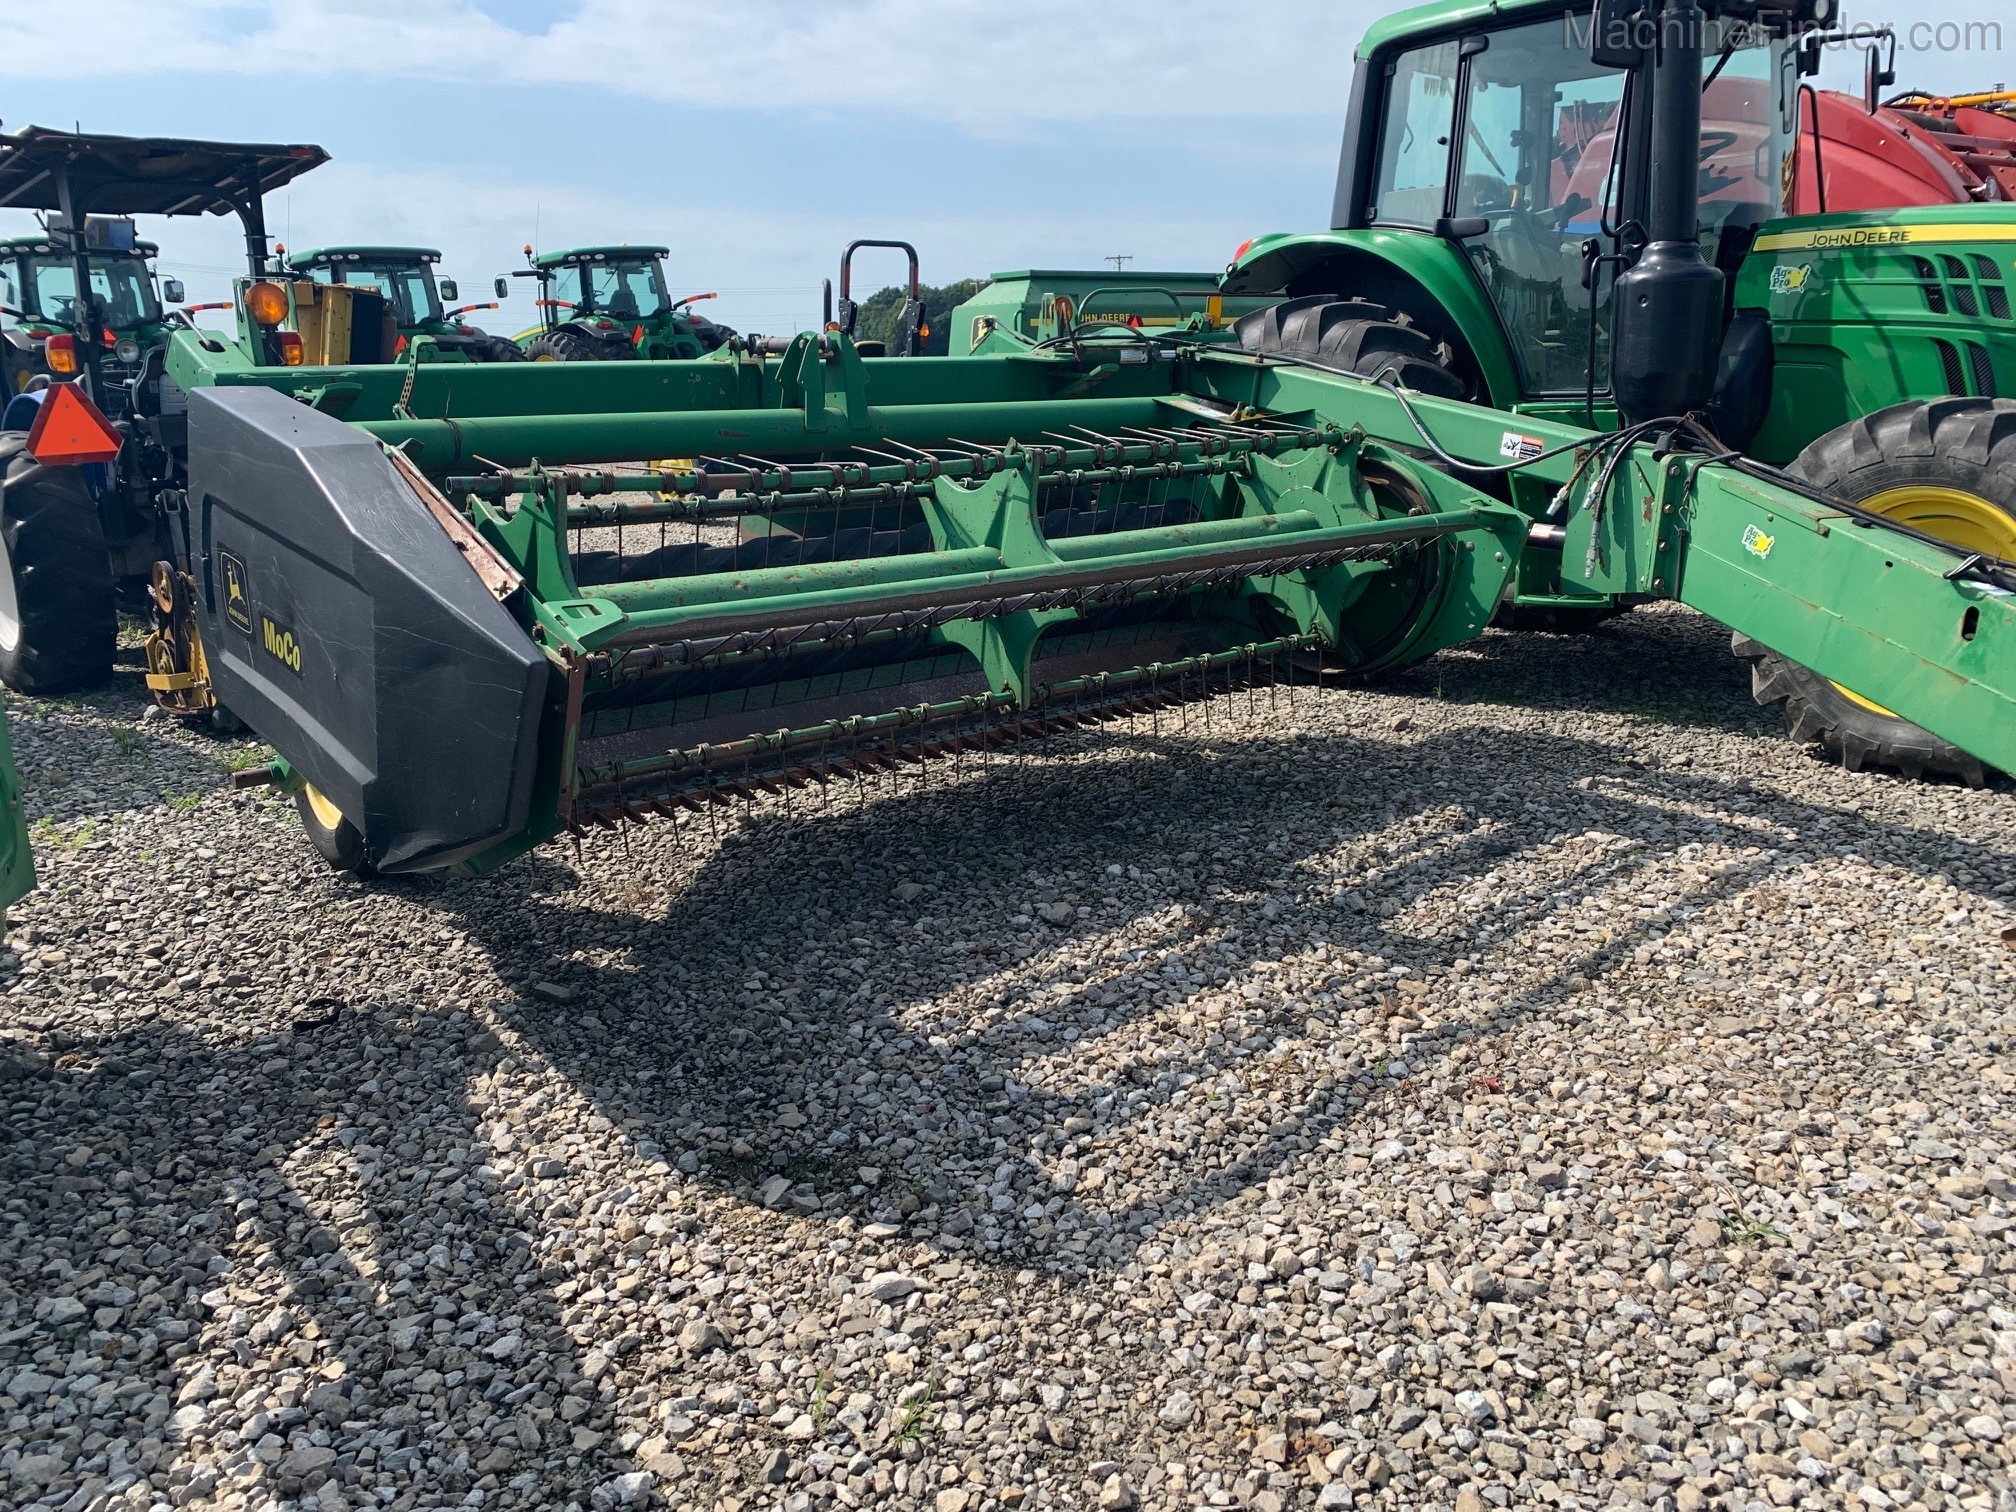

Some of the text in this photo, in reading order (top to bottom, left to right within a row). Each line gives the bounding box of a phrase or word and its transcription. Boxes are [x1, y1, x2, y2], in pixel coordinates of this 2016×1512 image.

[1807, 230, 1912, 247] JOHN DEERE
[263, 617, 301, 672] MoCo
